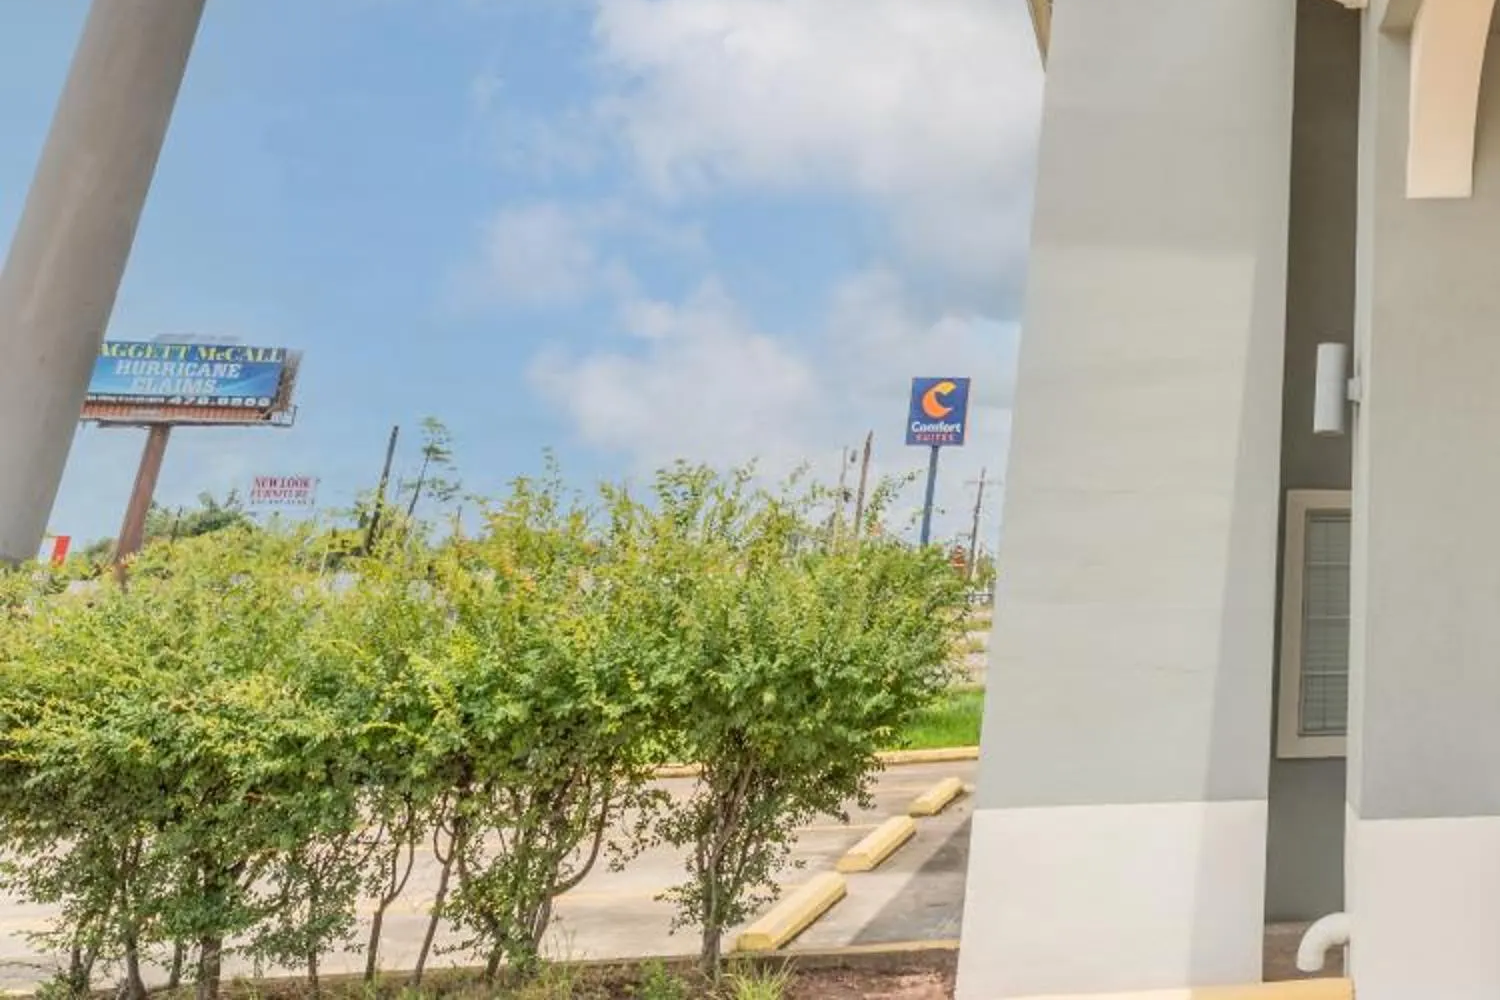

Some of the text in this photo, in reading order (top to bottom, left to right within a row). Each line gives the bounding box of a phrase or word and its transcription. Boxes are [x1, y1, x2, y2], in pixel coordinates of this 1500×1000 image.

[101, 342, 191, 360] AGGETT
[115, 359, 242, 379] HURRICANE
[911, 420, 961, 433] Comfort
